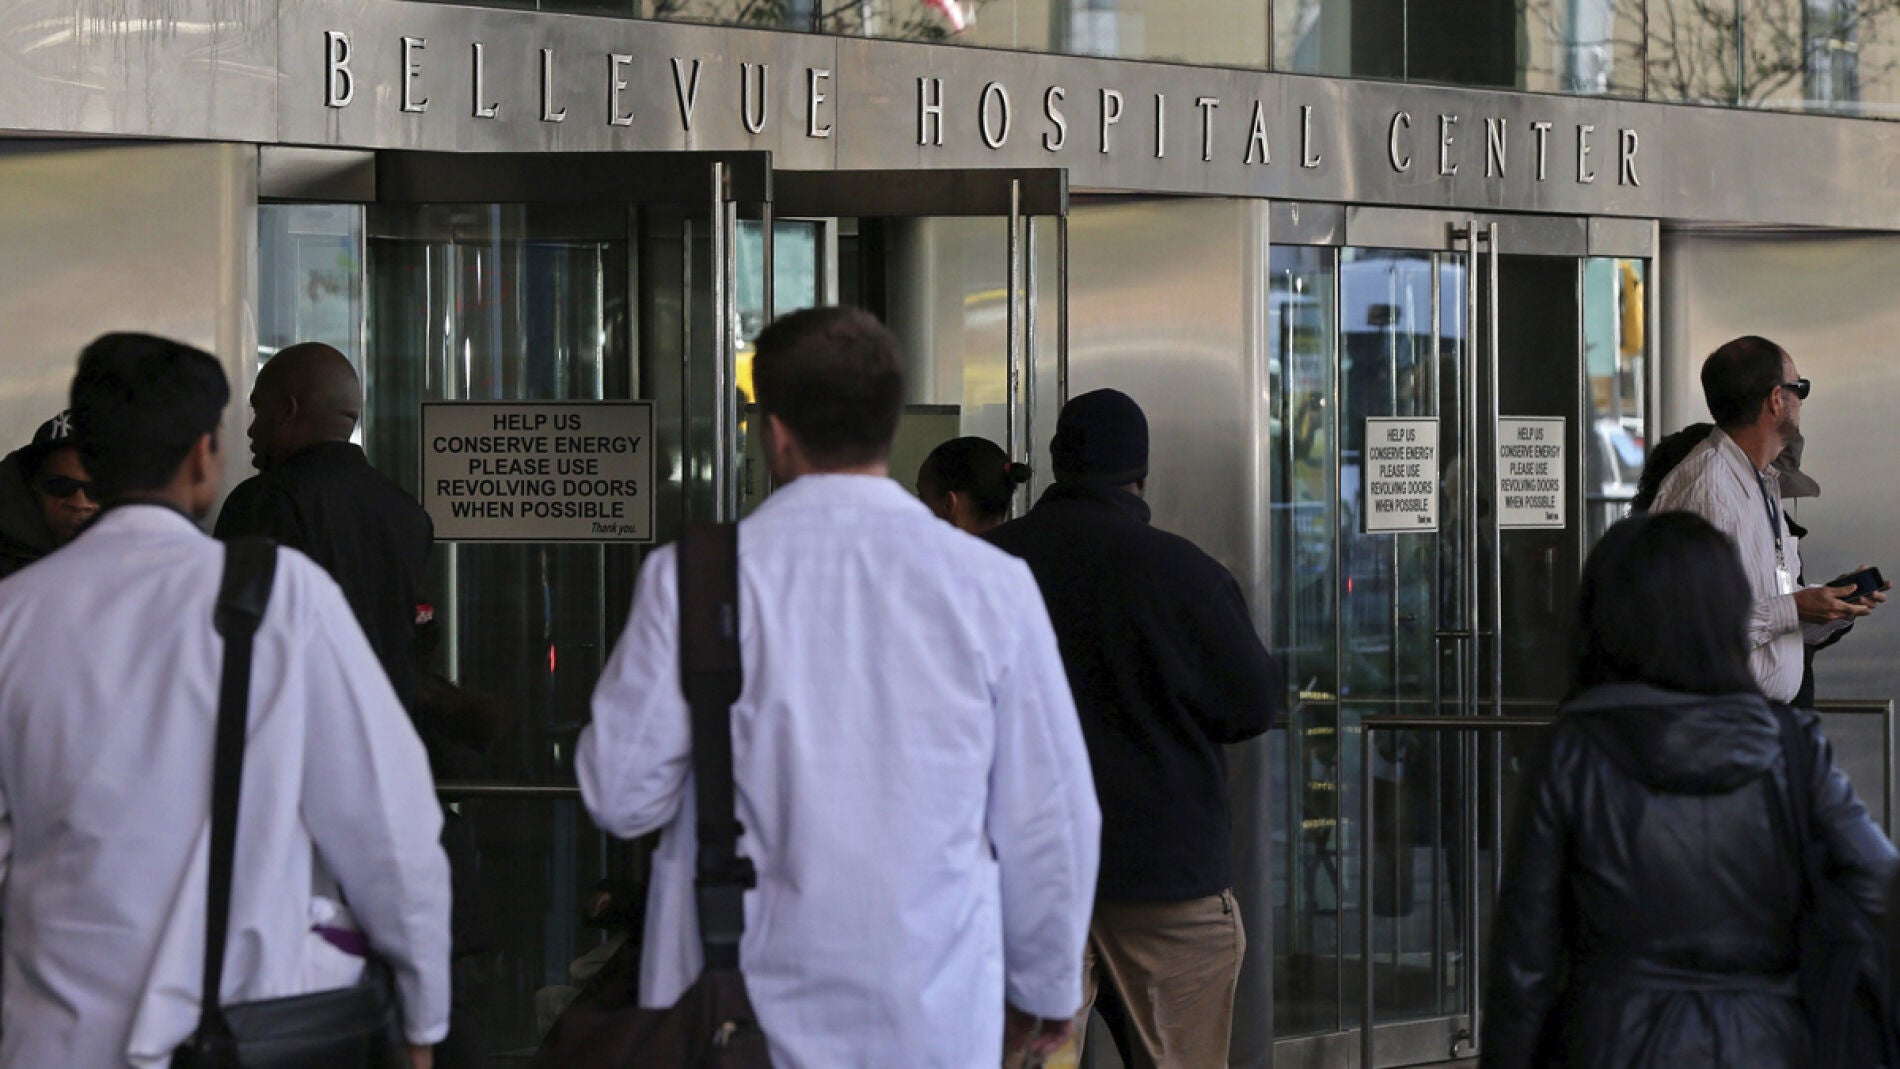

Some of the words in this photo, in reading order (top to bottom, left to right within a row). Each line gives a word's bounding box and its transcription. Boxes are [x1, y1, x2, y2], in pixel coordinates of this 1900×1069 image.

[324, 30, 832, 138] BELLEVUE
[917, 77, 1321, 168] HOSPITAL
[1388, 111, 1641, 187] CENTER
[493, 414, 547, 431] HELP
[553, 414, 582, 431] US
[1387, 428, 1404, 442] HELP
[1406, 428, 1416, 442] US
[433, 436, 547, 453] CONSERVE
[555, 436, 641, 453] ENERGY
[1370, 446, 1404, 460] CONSERVE
[1406, 446, 1434, 460] ENERGY
[469, 458, 550, 475] PLEASE
[557, 458, 599, 475] USE
[1380, 464, 1404, 477] PLEASE
[1406, 464, 1420, 477] USE
[437, 479, 556, 497] REVOLVING
[563, 479, 637, 497] DOORS
[1371, 481, 1406, 494] REVOLVING
[1408, 481, 1432, 494] DOORS
[452, 501, 514, 518] WHEN
[521, 501, 625, 518] POSSIBLE
[1375, 499, 1393, 512] WHEN
[1395, 499, 1428, 512] POSSIBLE
[591, 522, 617, 533] Thank
